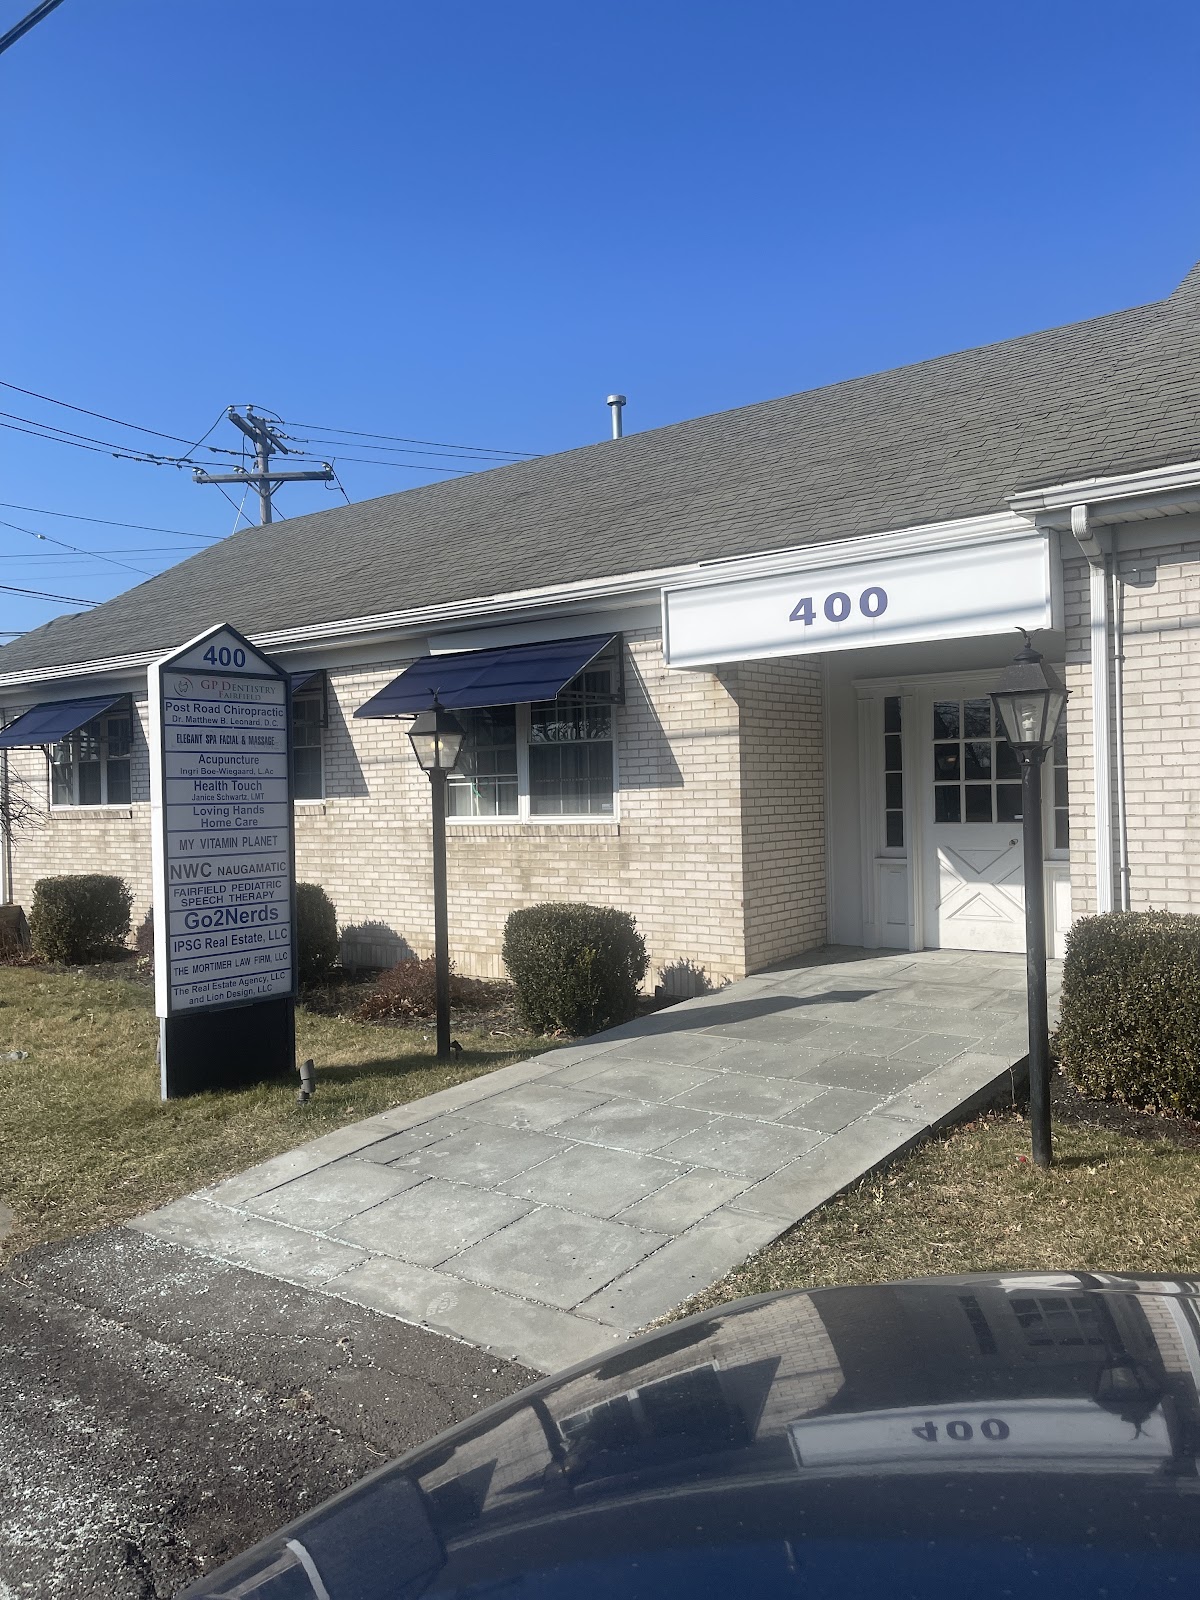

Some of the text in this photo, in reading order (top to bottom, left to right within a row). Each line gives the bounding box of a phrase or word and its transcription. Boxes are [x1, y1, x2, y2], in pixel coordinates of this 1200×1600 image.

[789, 587, 888, 626] 400
[203, 646, 246, 668] 400
[201, 680, 276, 694] GP DENTISTRY
[219, 690, 261, 700] FAIRFIELD
[166, 702, 284, 717] Post Road Chiropractic
[172, 715, 183, 723] Dr.
[186, 716, 218, 724] Matthew
[220, 717, 228, 725] B.
[230, 718, 262, 726] Leonard,
[176, 734, 274, 745] ELEGANT SPA FACIAL & MASSAGE
[199, 754, 259, 766] Acupuncture
[180, 768, 198, 776] Ingri
[201, 768, 255, 776] Boe-Wiegaard,
[194, 780, 262, 791] Health Touch
[217, 793, 248, 801] Schwartz,
[193, 805, 264, 817] Loving Hands
[201, 817, 258, 828] Home Care
[180, 836, 278, 850] MY VITAMIN PLANET
[170, 862, 286, 880] NWC NAUGAMATIC
[174, 881, 281, 897] FAIRFIELD PEDIATRIC
[182, 891, 274, 907] SPEECH THERAPY
[185, 905, 279, 929] Go2Nerds
[174, 928, 287, 952] IPSG Real Estate, LLC
[174, 952, 288, 976] THE MORTIMER LAW FIRM, LLC
[174, 972, 285, 996] The Real Estate Agency, LLC
[189, 984, 272, 1005] and Lion Design, LLC
